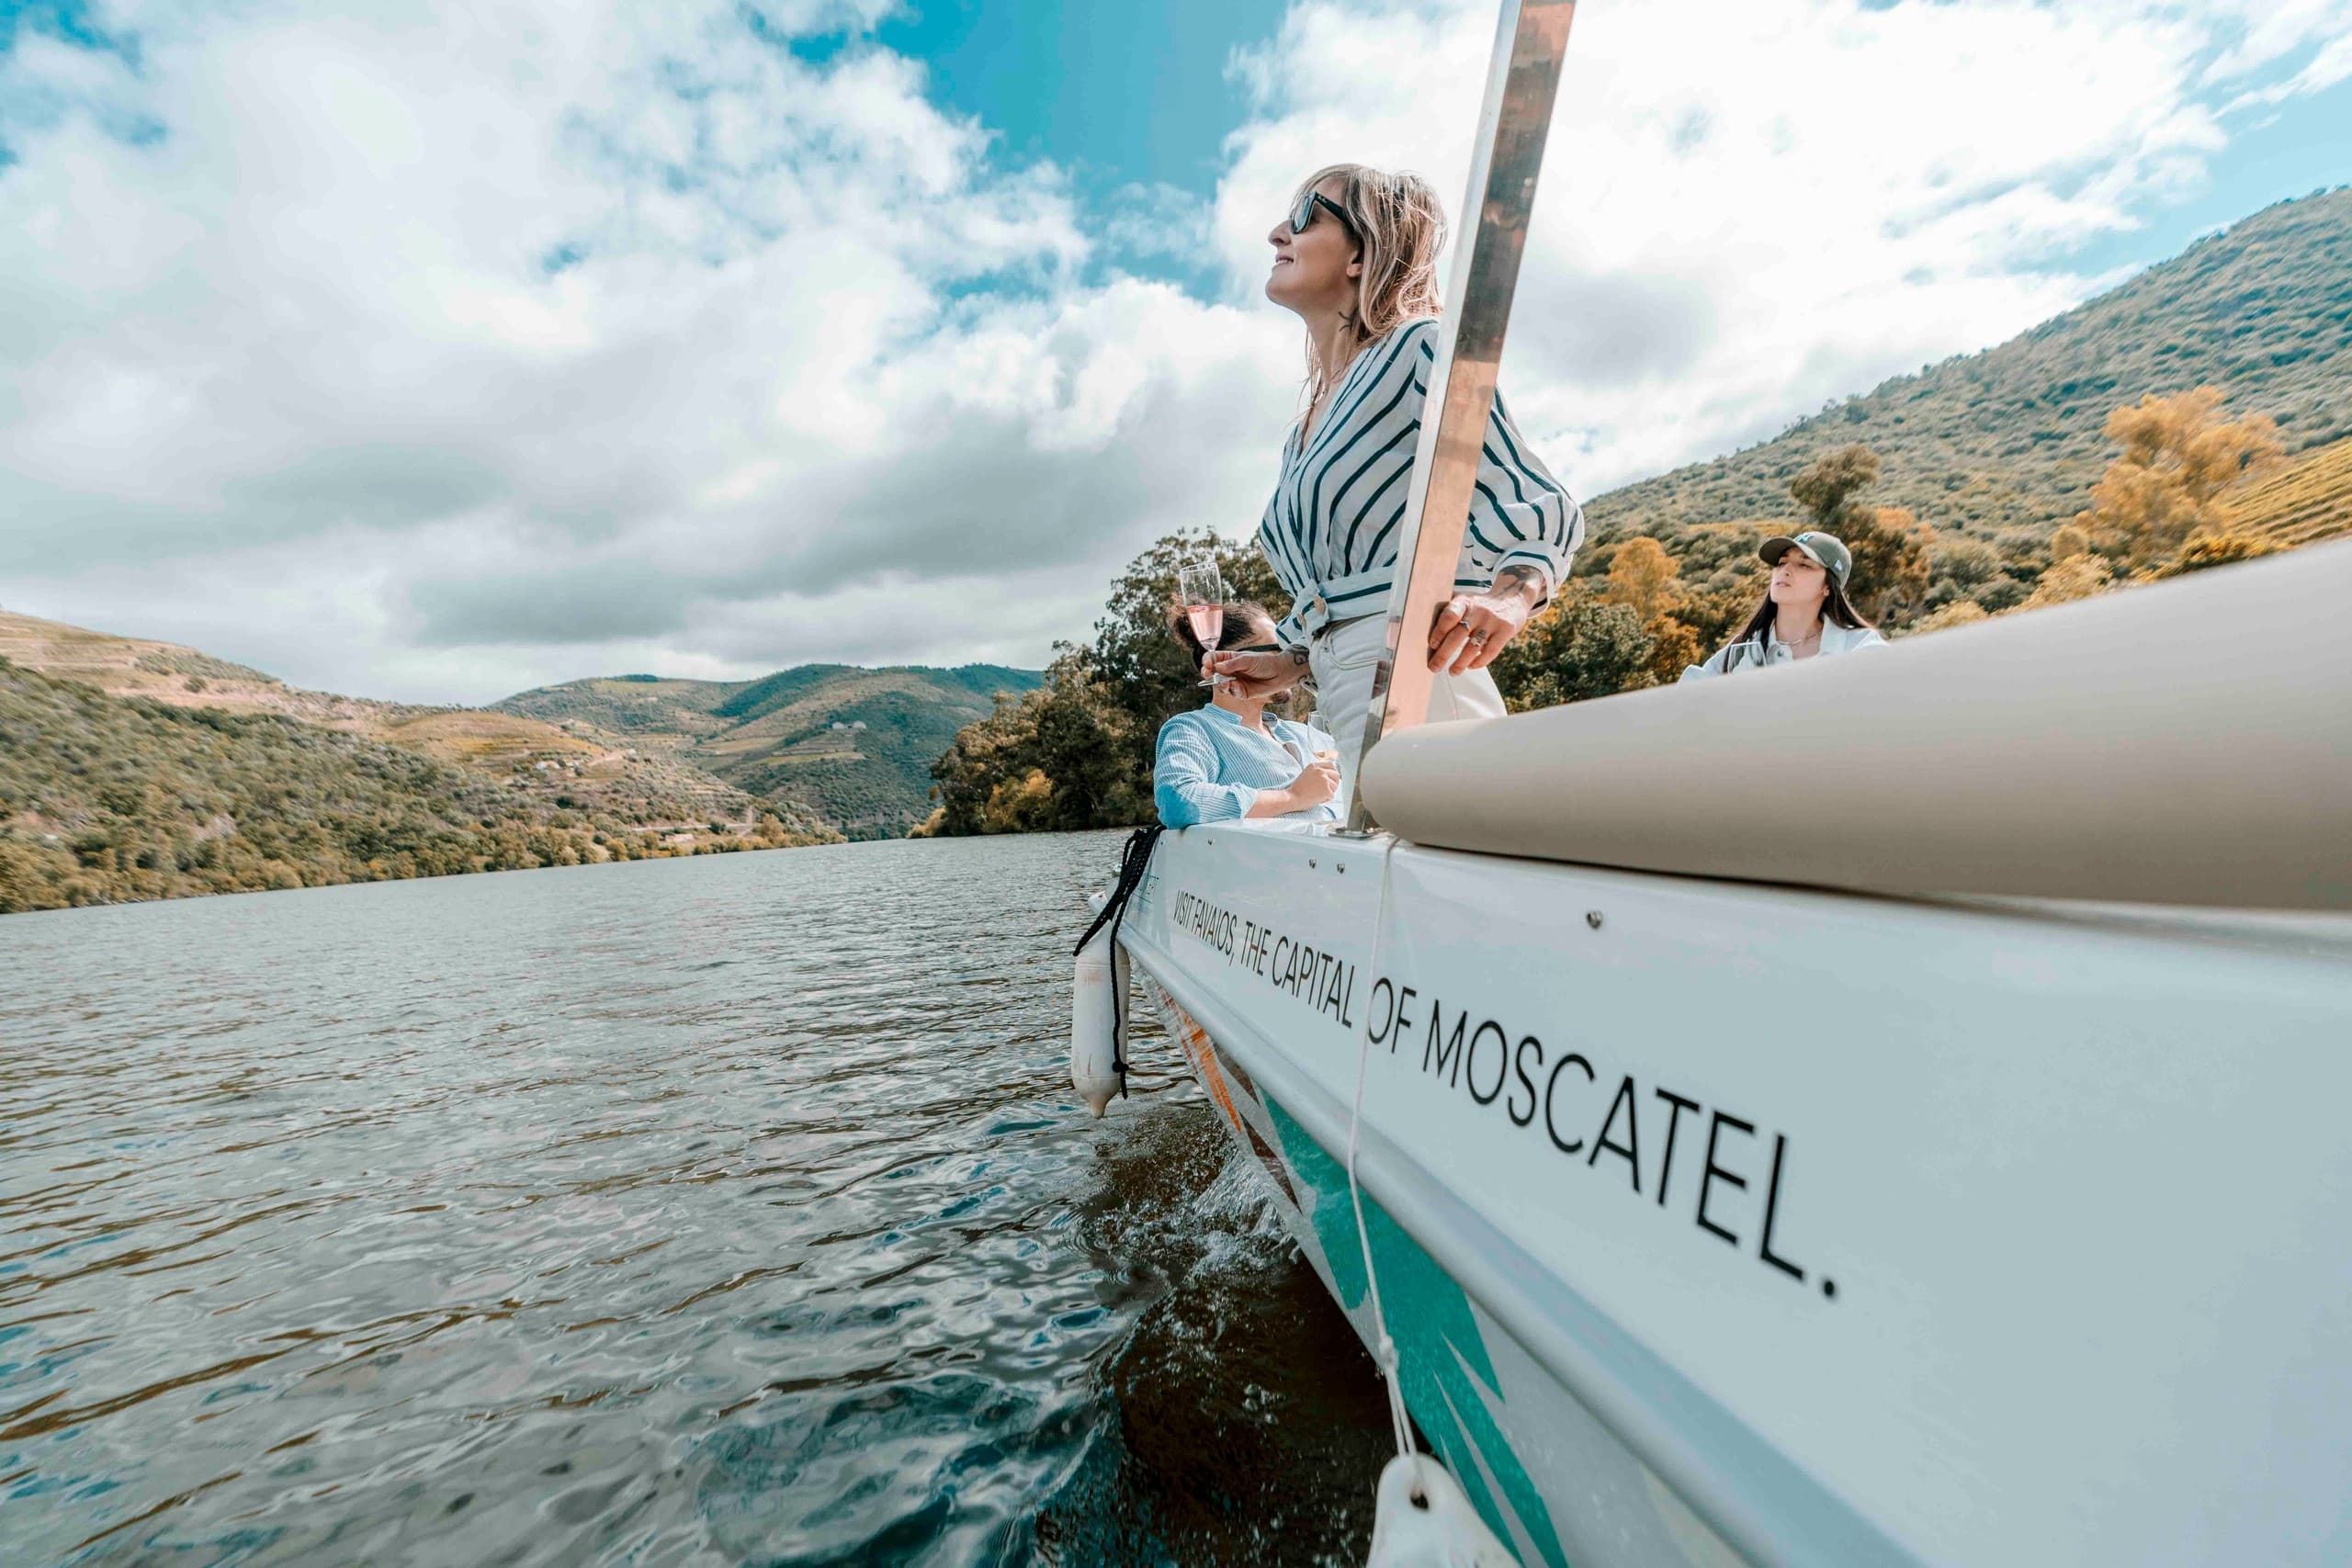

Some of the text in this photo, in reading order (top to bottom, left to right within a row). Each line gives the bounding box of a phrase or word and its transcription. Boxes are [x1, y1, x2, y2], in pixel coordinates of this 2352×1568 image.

[1173, 889, 1839, 1298] VISIT FAVAIOS, THE CAPITAL OF MOSCATEL.
